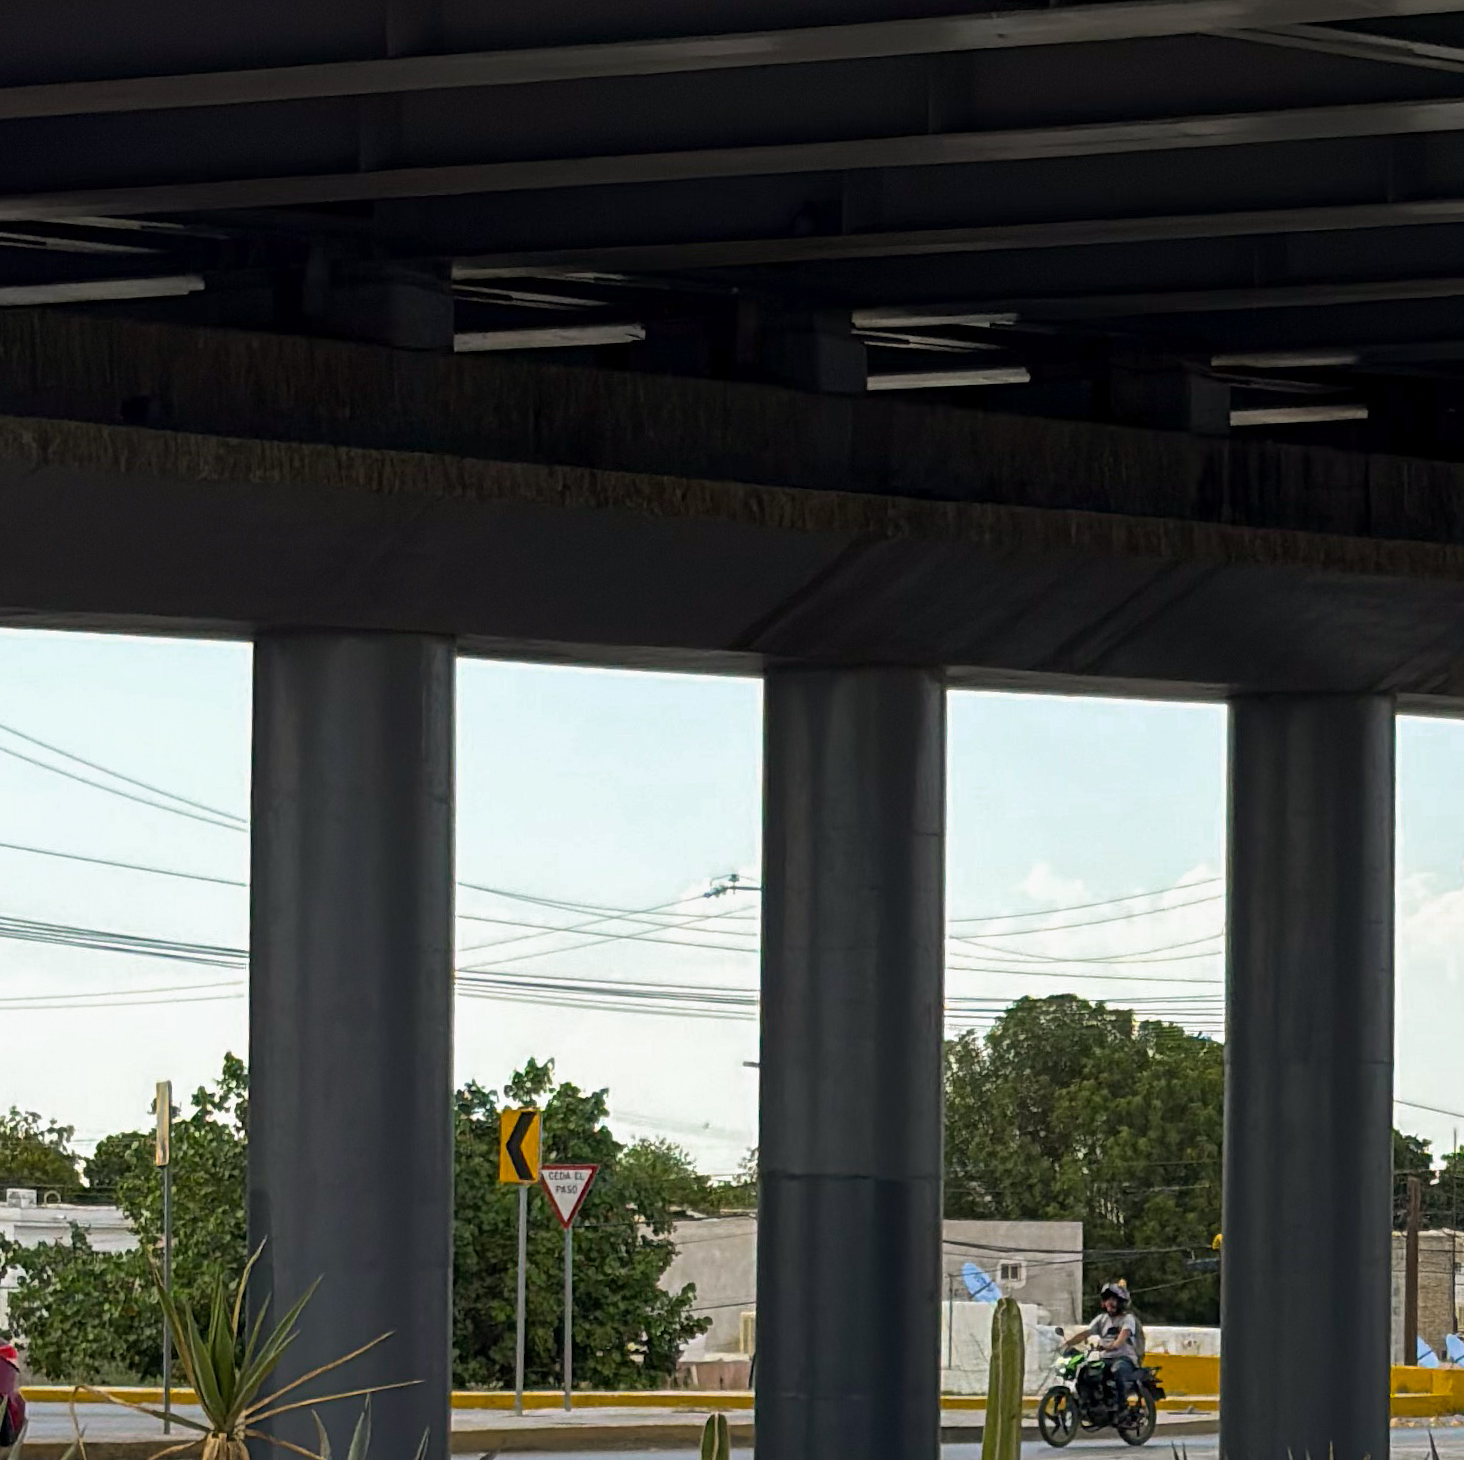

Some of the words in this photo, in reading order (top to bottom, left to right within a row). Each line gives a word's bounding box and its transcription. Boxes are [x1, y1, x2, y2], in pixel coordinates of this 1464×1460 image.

[548, 1171, 571, 1181] CEDA
[574, 1171, 585, 1181] EL
[555, 1185, 578, 1194] PASO
